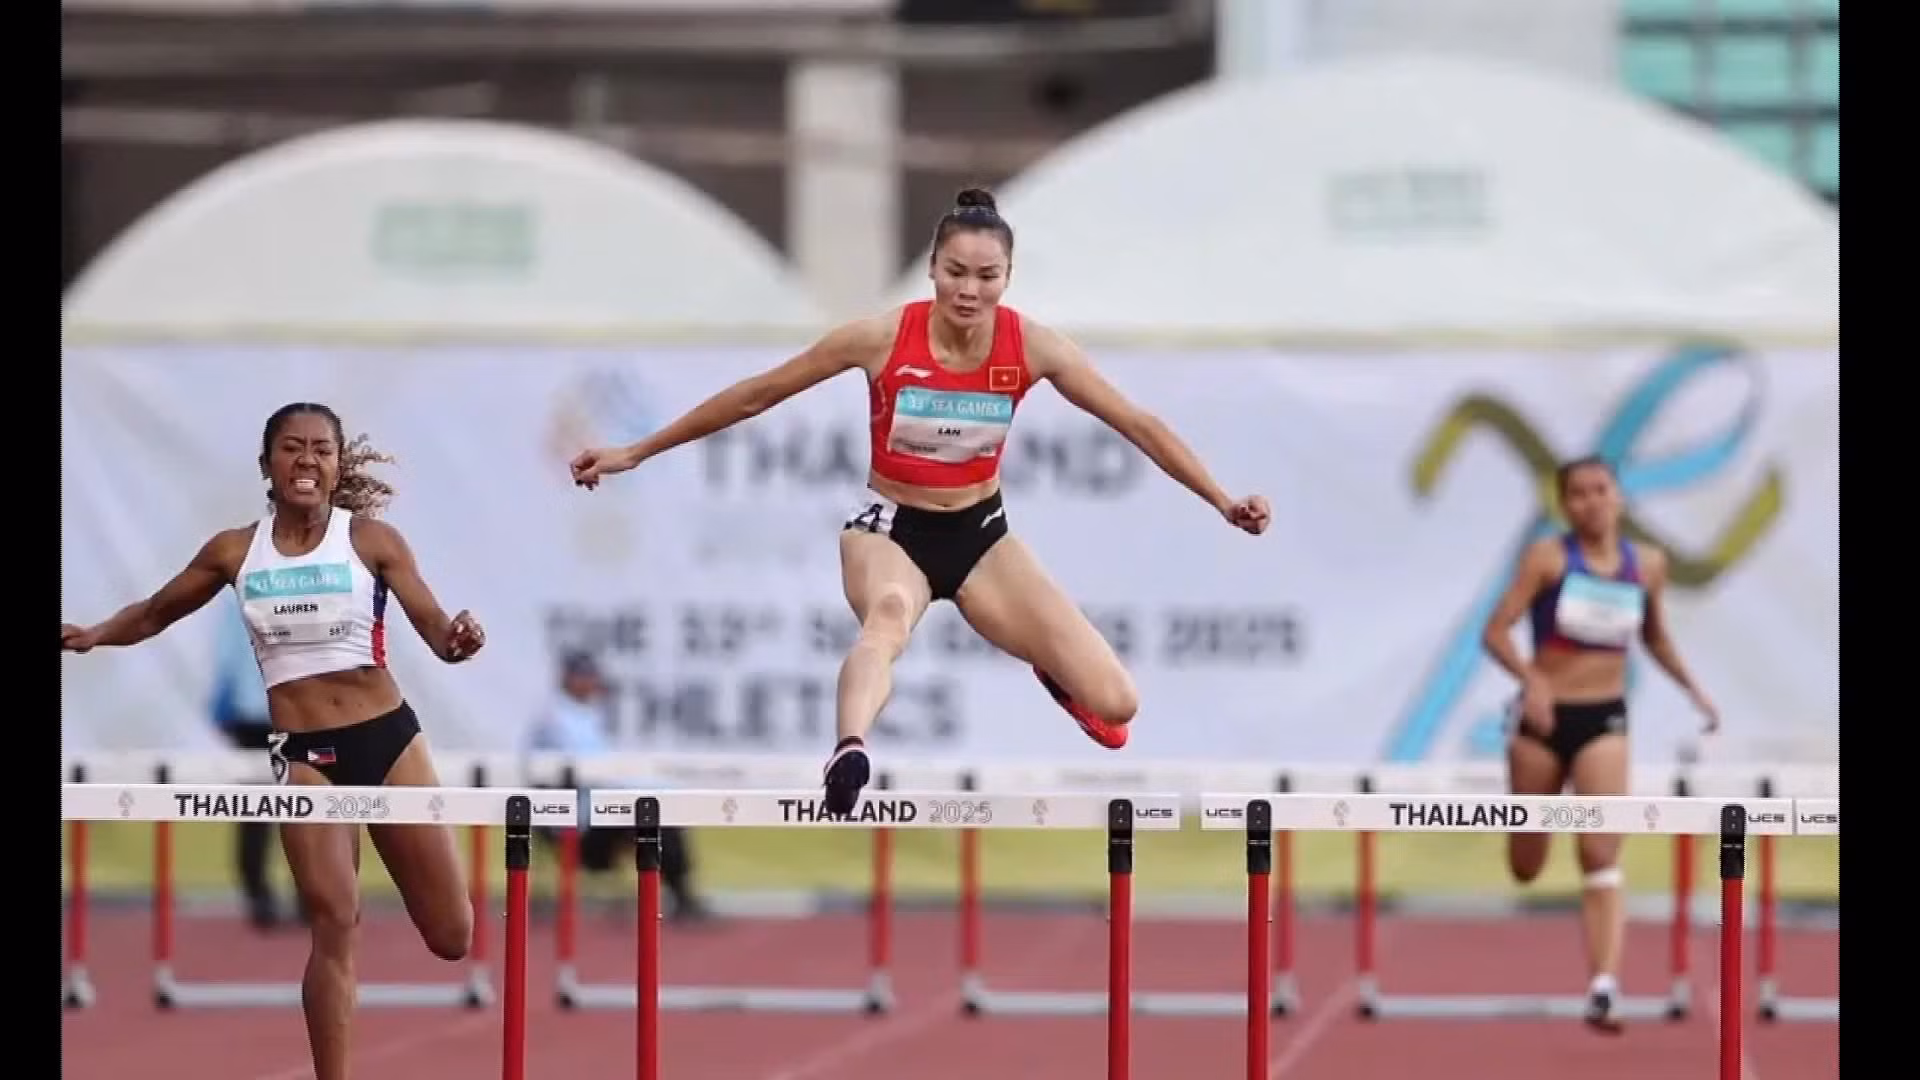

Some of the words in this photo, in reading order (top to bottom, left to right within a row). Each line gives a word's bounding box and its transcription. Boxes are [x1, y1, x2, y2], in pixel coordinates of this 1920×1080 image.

[957, 400, 1000, 417] GAMES
[937, 427, 961, 437] LAN
[273, 603, 320, 616] LAUREN
[174, 793, 314, 818] THAILAND
[324, 795, 391, 819] 2025
[532, 803, 571, 815] UCS
[593, 803, 633, 815] UCS
[928, 800, 993, 824] 2025
[1134, 808, 1173, 819] UCS
[1204, 808, 1243, 819] UCS
[1389, 803, 1529, 827] THAILAND
[1540, 805, 1605, 829] 2025
[1746, 813, 1785, 823] UCS
[1799, 813, 1838, 824] UCS
